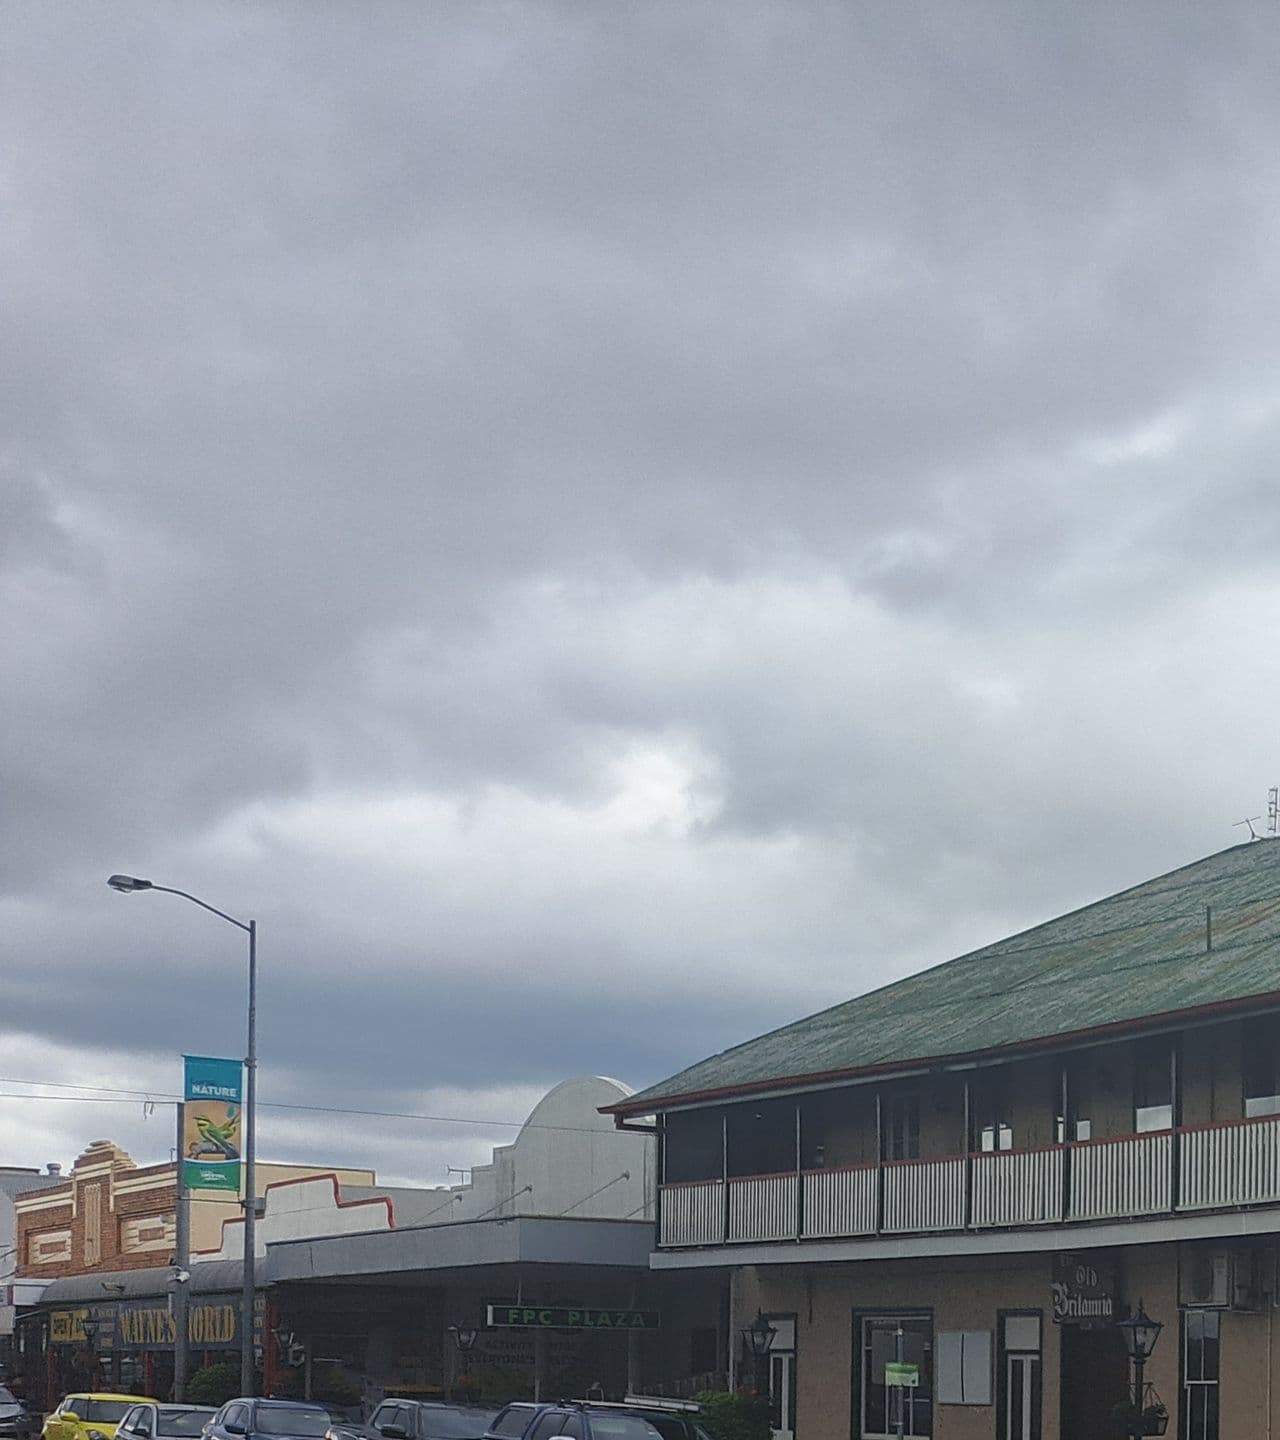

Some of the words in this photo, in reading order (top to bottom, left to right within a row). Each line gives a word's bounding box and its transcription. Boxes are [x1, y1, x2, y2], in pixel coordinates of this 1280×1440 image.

[192, 1084, 237, 1097] NATURE
[188, 1304, 236, 1343] ORLD
[509, 1309, 553, 1325] FPC
[569, 1310, 645, 1327] PLAZA
